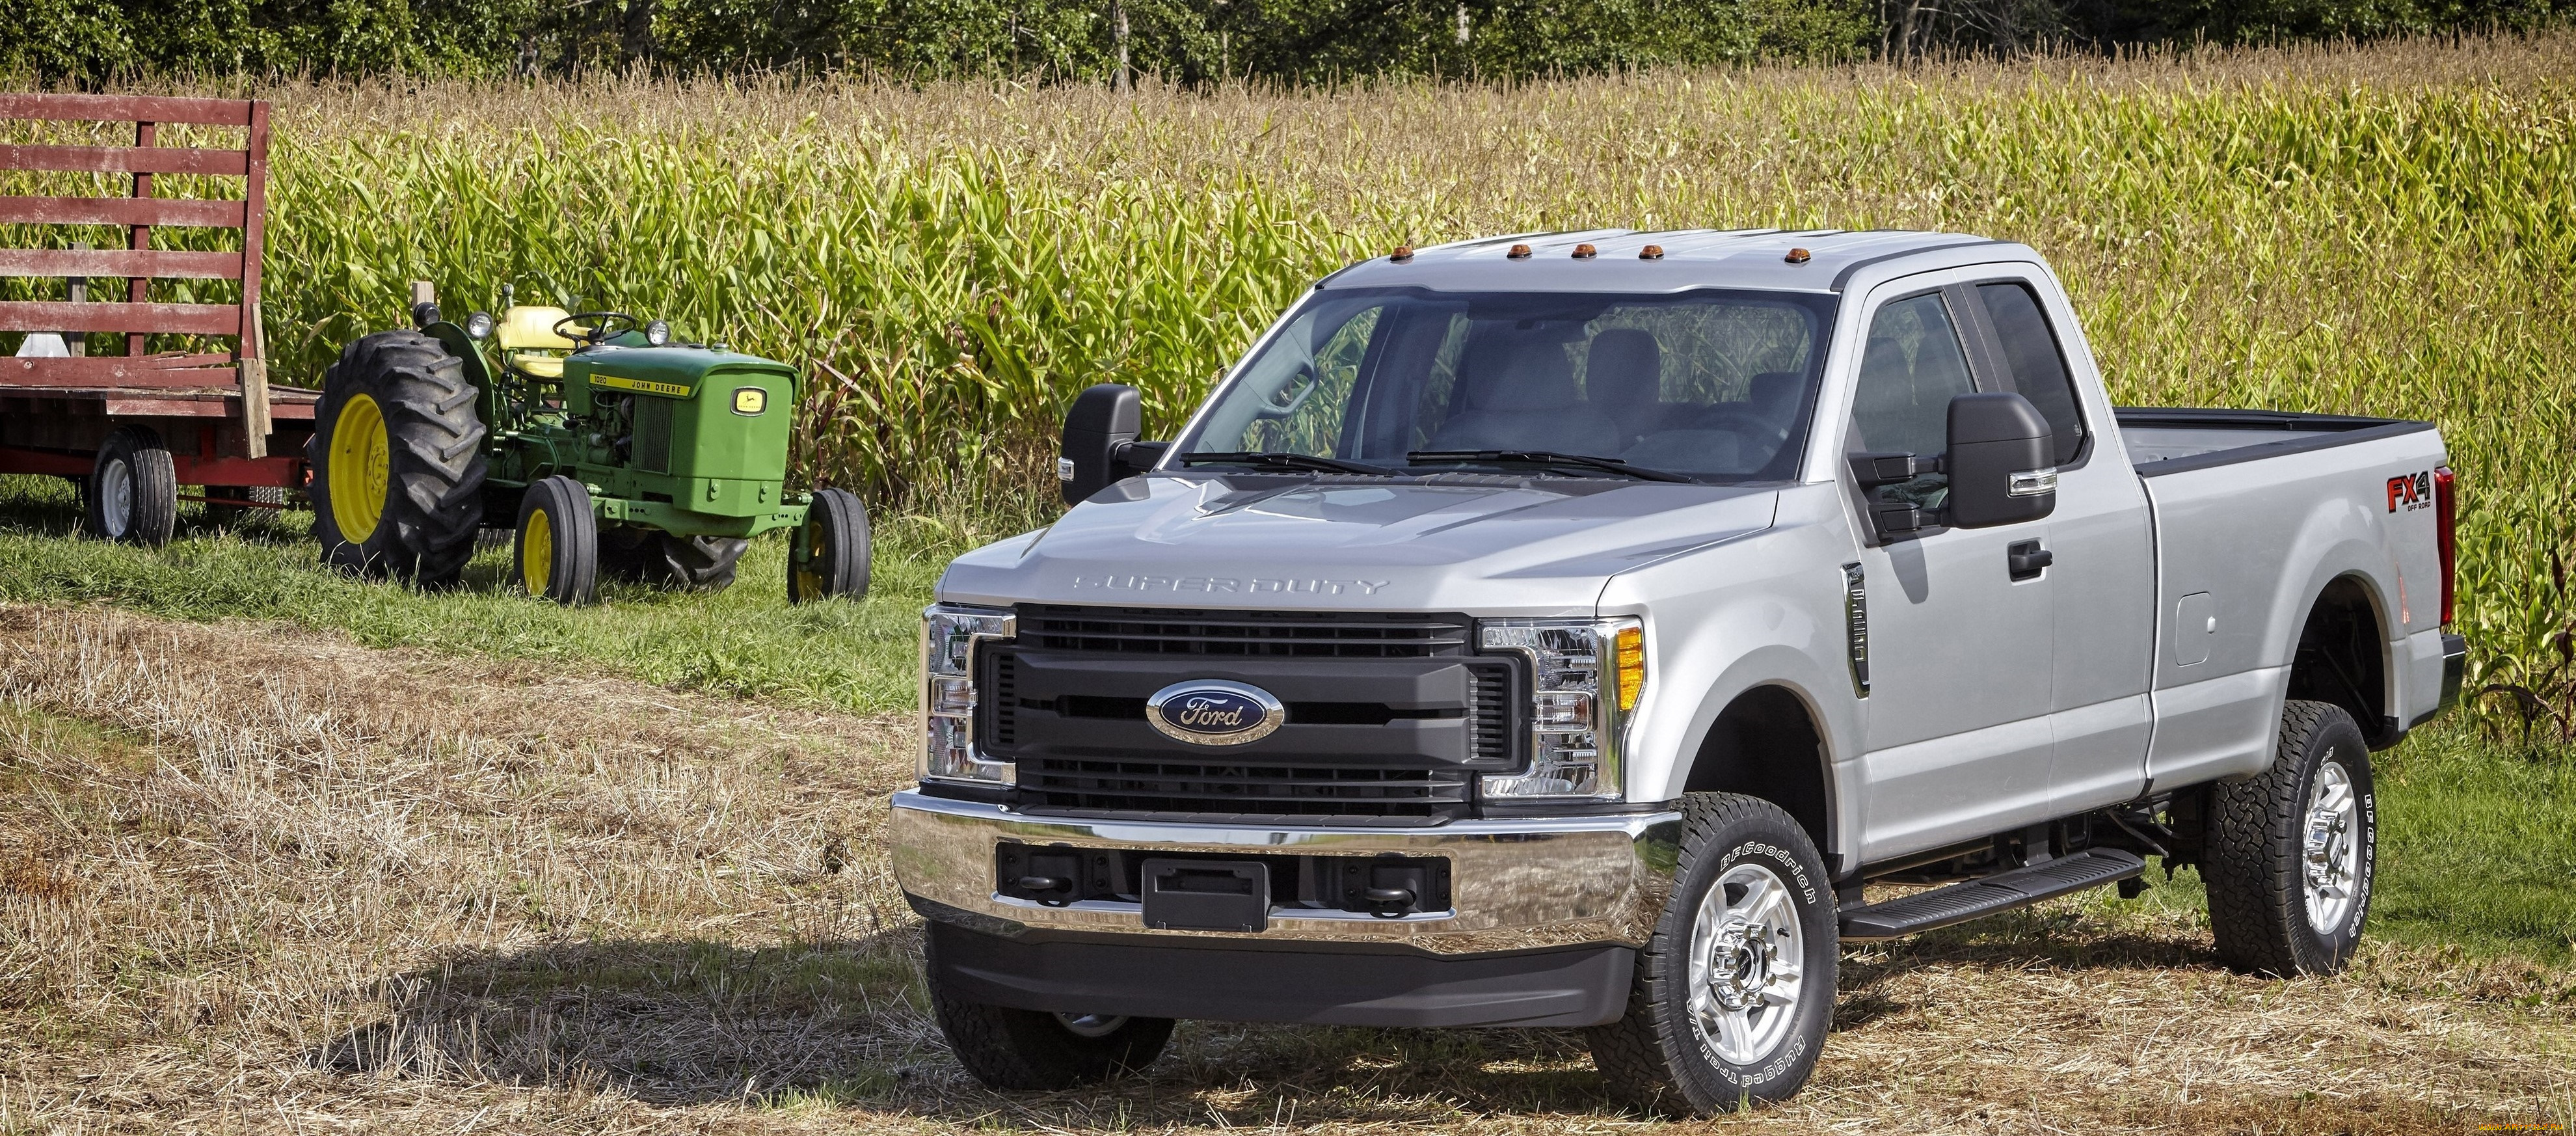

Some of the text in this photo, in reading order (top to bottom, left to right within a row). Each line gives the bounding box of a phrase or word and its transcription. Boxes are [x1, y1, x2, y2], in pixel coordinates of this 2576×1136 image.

[595, 376, 681, 394] 1020 JOHN DEERE
[2387, 470, 2431, 514] FX4
[2408, 501, 2431, 512] OFF ROAD
[1073, 575, 1391, 595] SUPER DUTY
[1180, 696, 1244, 726] Ford
[1720, 841, 1817, 904] BFGoodrich
[2349, 794, 2374, 938] BFGoodrich
[1700, 1043, 1737, 1085] Trail
[1742, 1035, 1806, 1088] Rugged
